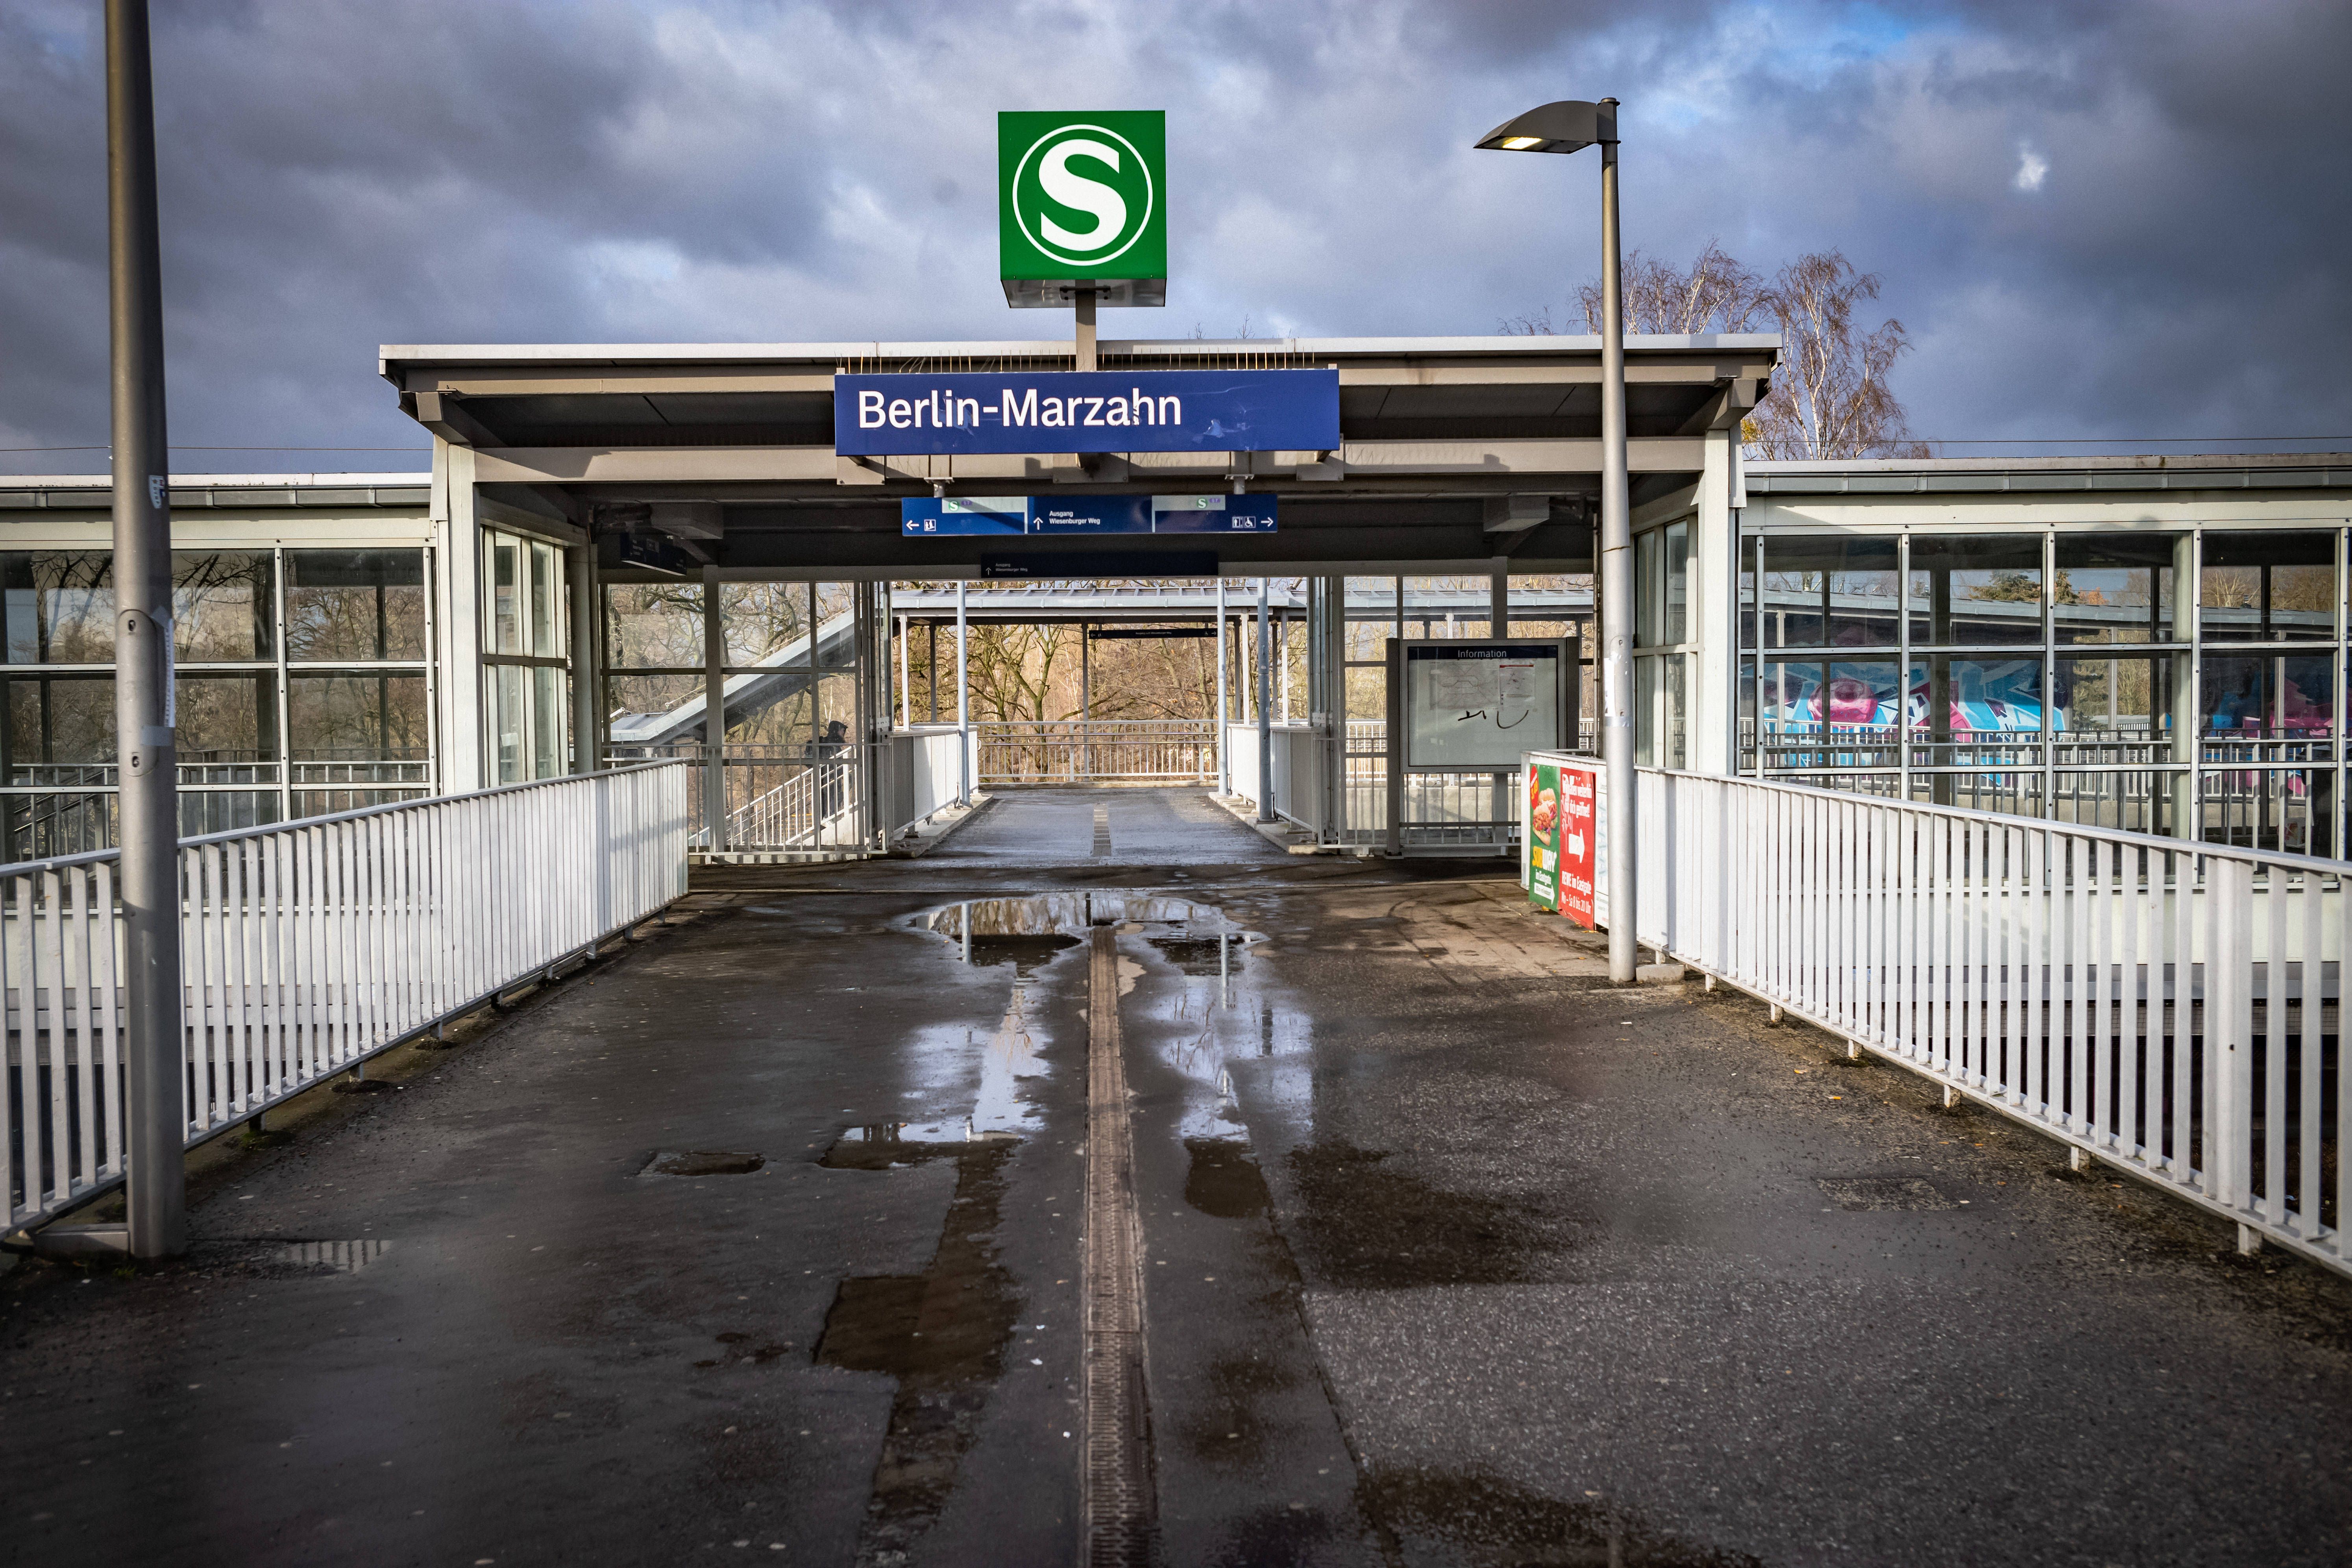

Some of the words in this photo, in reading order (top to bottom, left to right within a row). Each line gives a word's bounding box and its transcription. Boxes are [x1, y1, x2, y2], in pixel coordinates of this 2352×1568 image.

[1039, 139, 1127, 251] S
[858, 387, 1181, 428] Berlin-Marzahn
[950, 501, 958, 511] S
[1198, 499, 1206, 508] S
[1457, 650, 1507, 658] Information
[1532, 846, 1557, 873] SUBWAY
[1562, 871, 1572, 887] REWE
[1572, 873, 1577, 889] im
[1577, 876, 1592, 896] Eastgate
[1561, 891, 1566, 904] Mo
[1569, 894, 1573, 907] Sa
[1581, 899, 1585, 912] 20
